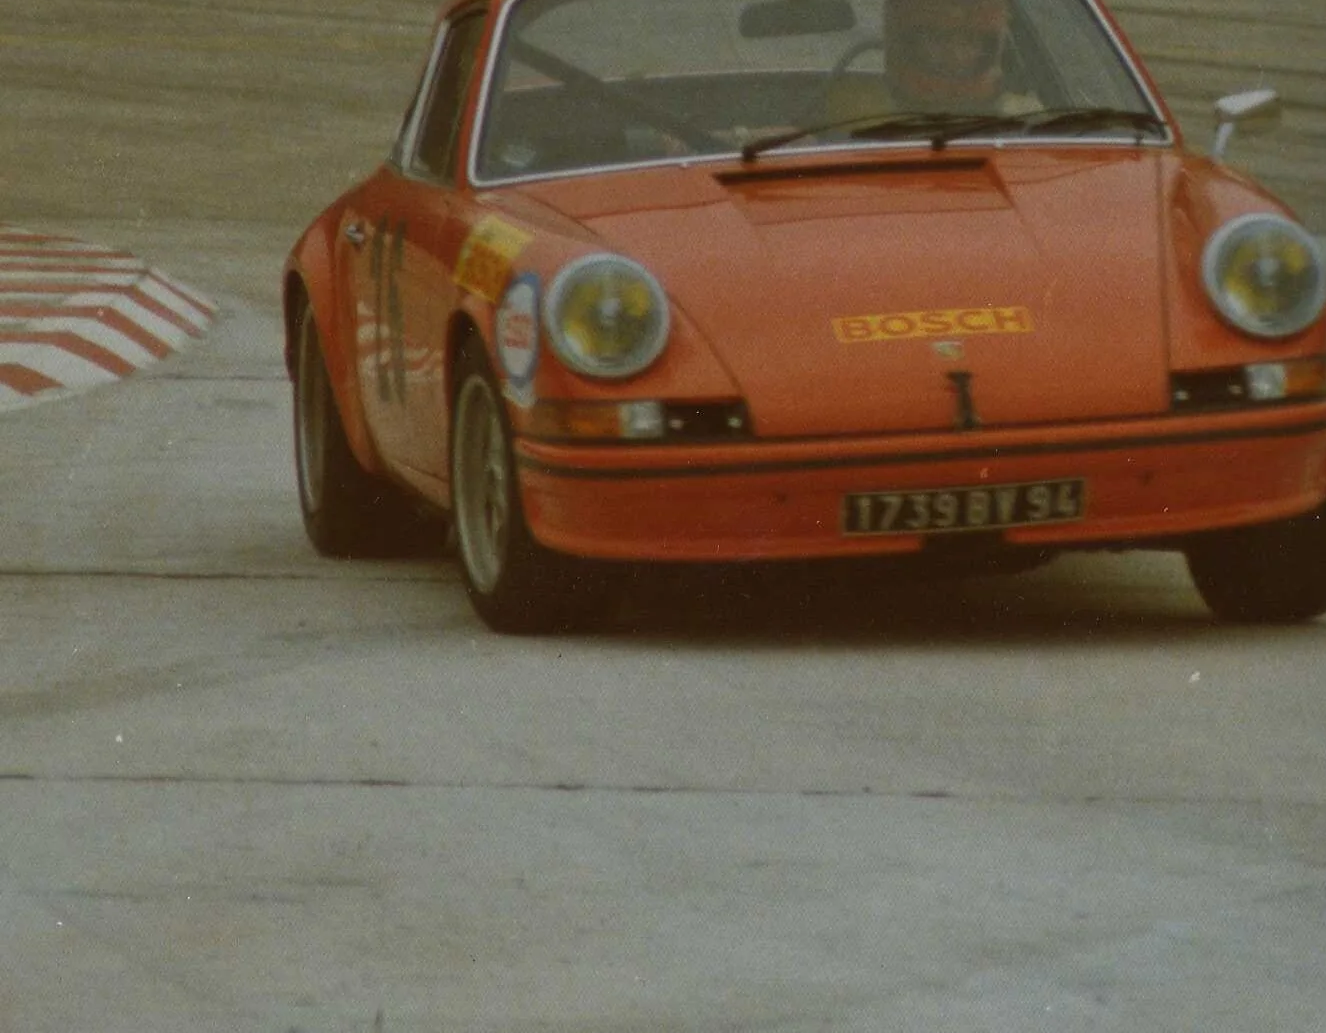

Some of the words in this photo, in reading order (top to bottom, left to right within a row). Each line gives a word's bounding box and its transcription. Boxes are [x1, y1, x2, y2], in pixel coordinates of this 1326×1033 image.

[840, 308, 1029, 340] BOSCH
[855, 494, 957, 530] 1739
[1026, 482, 1077, 519] 94
